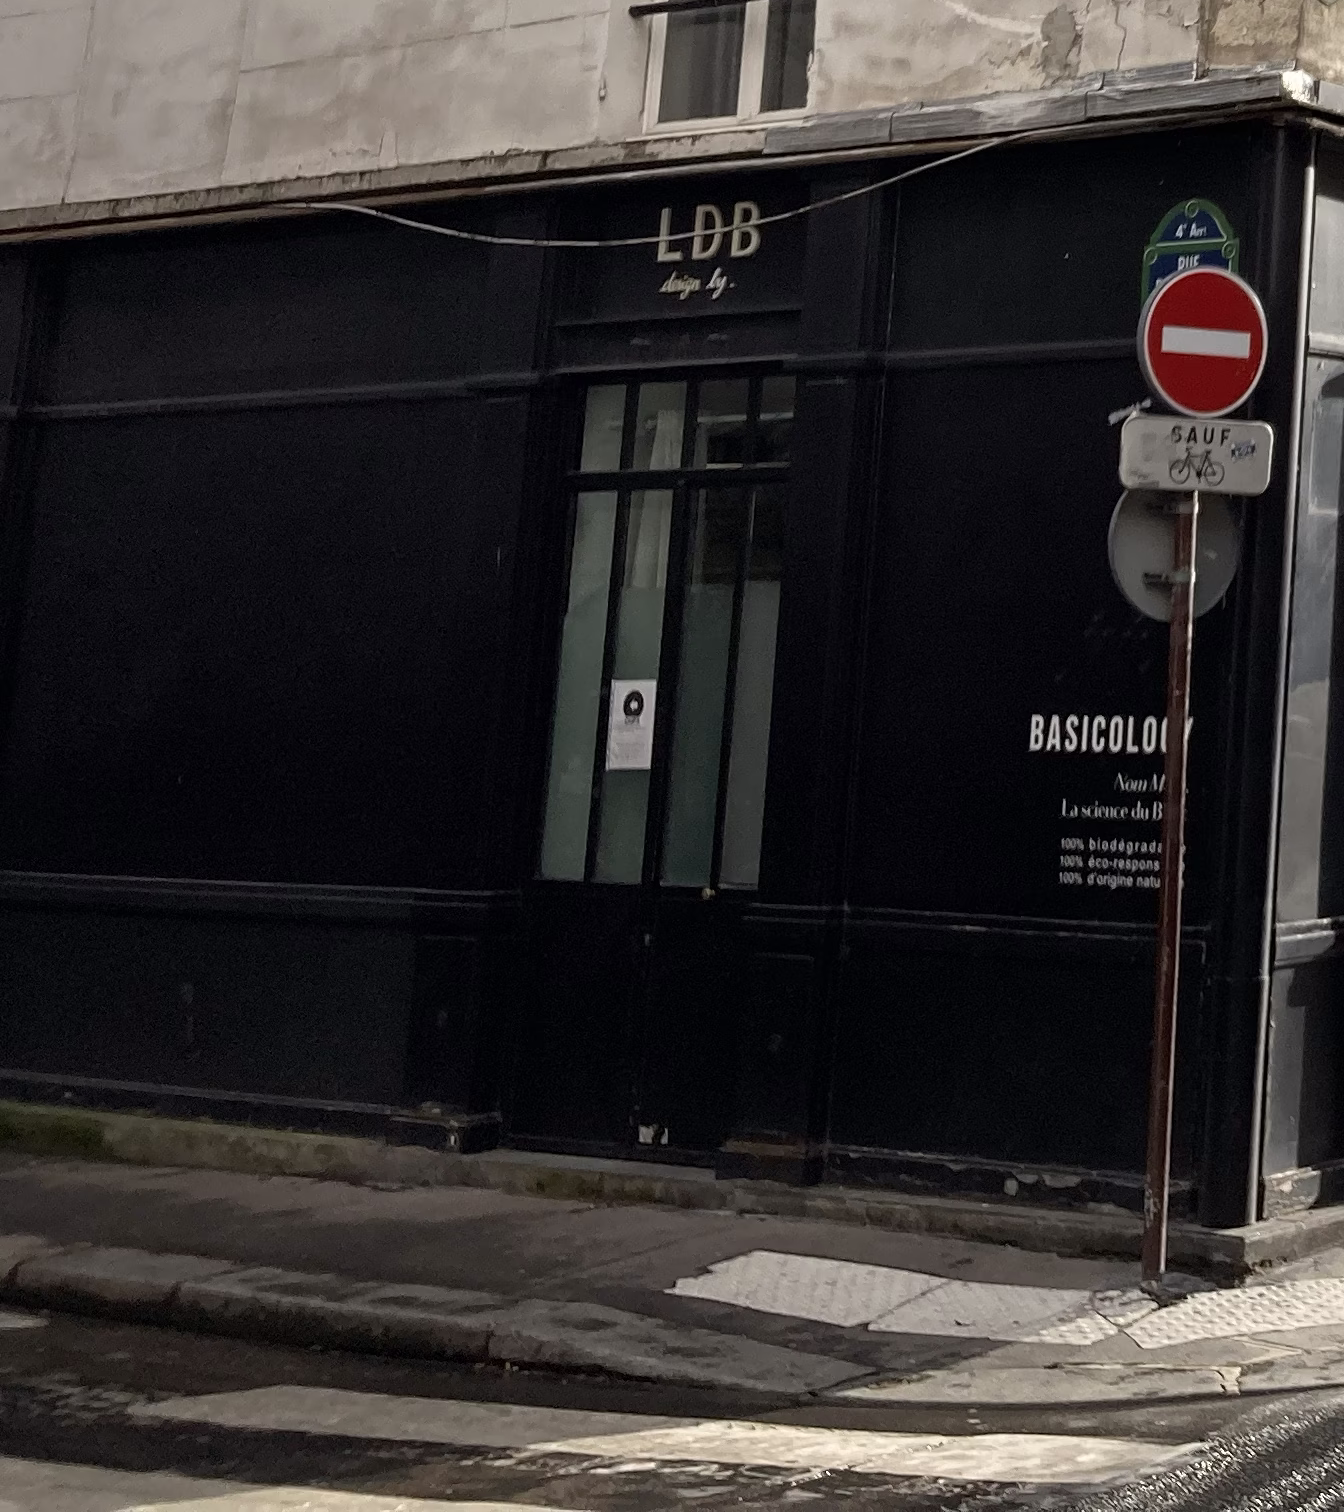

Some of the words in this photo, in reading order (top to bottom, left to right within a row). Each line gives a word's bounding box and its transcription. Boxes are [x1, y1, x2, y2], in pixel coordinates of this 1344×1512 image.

[658, 201, 760, 261] LDB
[659, 270, 701, 300] design
[1172, 426, 1231, 446] SAUF
[1114, 772, 1147, 792] Nom
[1061, 798, 1078, 818] La
[1081, 800, 1128, 819] science
[1131, 800, 1149, 820] du
[1061, 838, 1084, 851] 100%
[1060, 855, 1083, 868] 100%
[1059, 872, 1082, 885] 100%
[1087, 873, 1133, 890] d'origine
